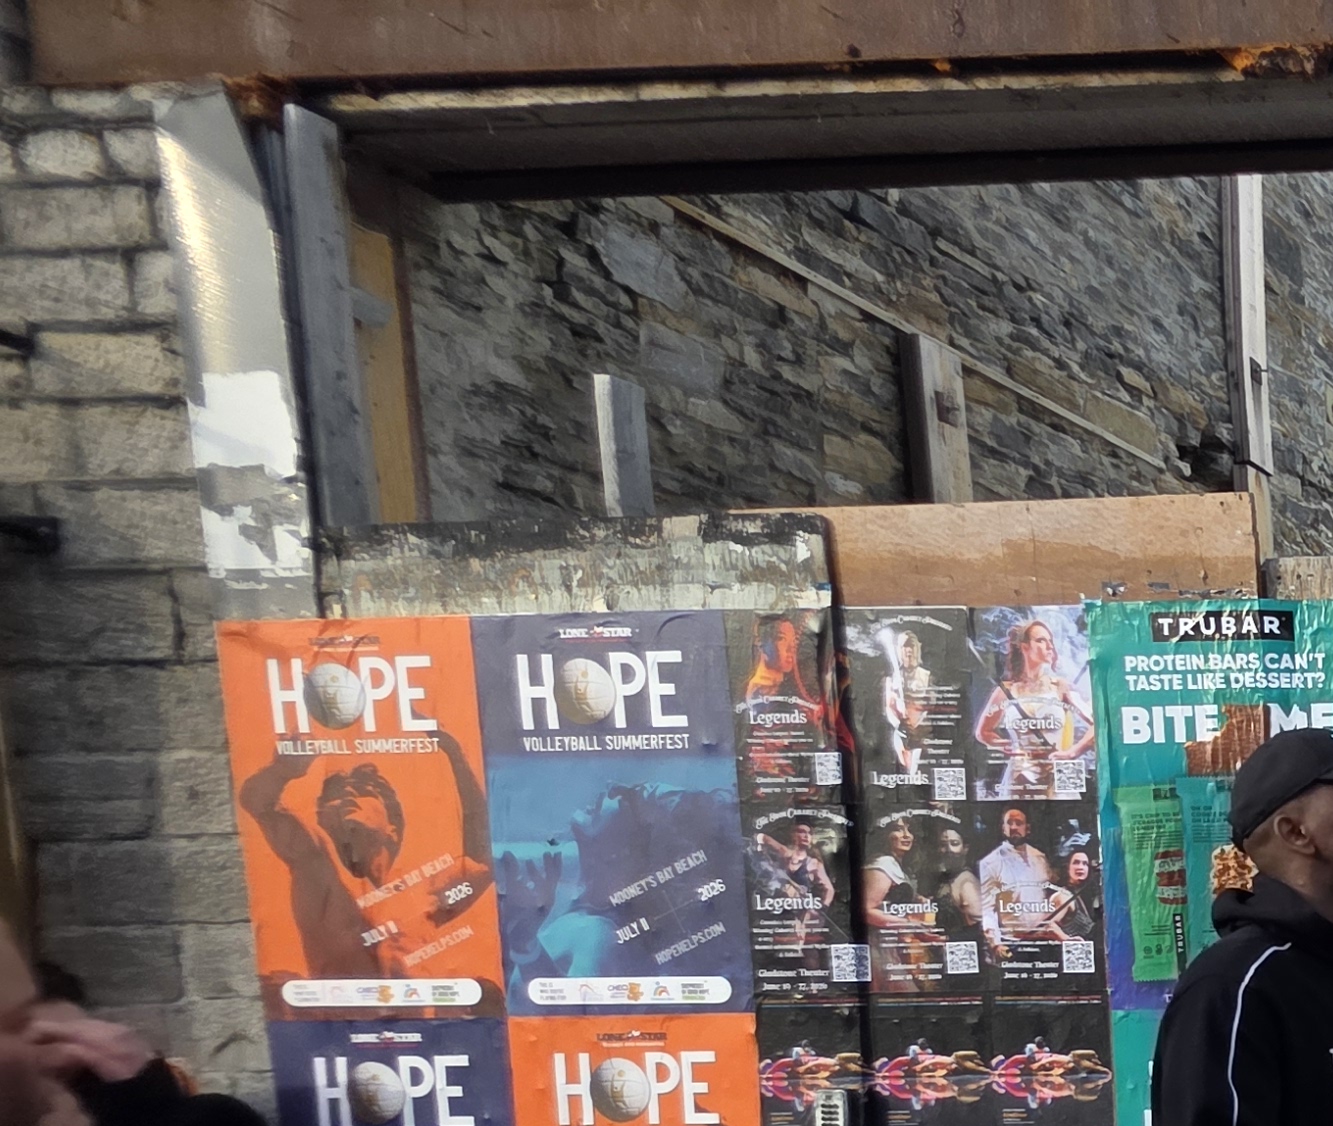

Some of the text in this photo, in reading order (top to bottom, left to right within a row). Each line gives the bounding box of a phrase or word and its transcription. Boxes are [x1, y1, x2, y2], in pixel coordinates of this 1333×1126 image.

[1157, 616, 1281, 636] TRUBAR
[1125, 652, 1326, 672] PROTEIN BARS CAN'T
[1125, 672, 1326, 691] TASTE LIKE DESSERT?
[750, 710, 807, 727] Legends
[1003, 715, 1063, 735] Legends
[1121, 704, 1219, 744] BITE
[276, 738, 440, 755] VOLLEYBALL SUMMERFEST
[523, 734, 690, 751] VOLLEYBALL SUMMERFEST
[872, 771, 929, 788] Legends
[609, 850, 707, 907] MOONEY'S BAY BEACH
[445, 882, 473, 904] 2026
[697, 879, 726, 901] 2026
[755, 895, 822, 914] Legends
[882, 899, 938, 917] Legends
[999, 899, 1056, 917] Legends
[615, 922, 640, 944] JULY
[655, 921, 726, 965] HOPEHELPS.COM
